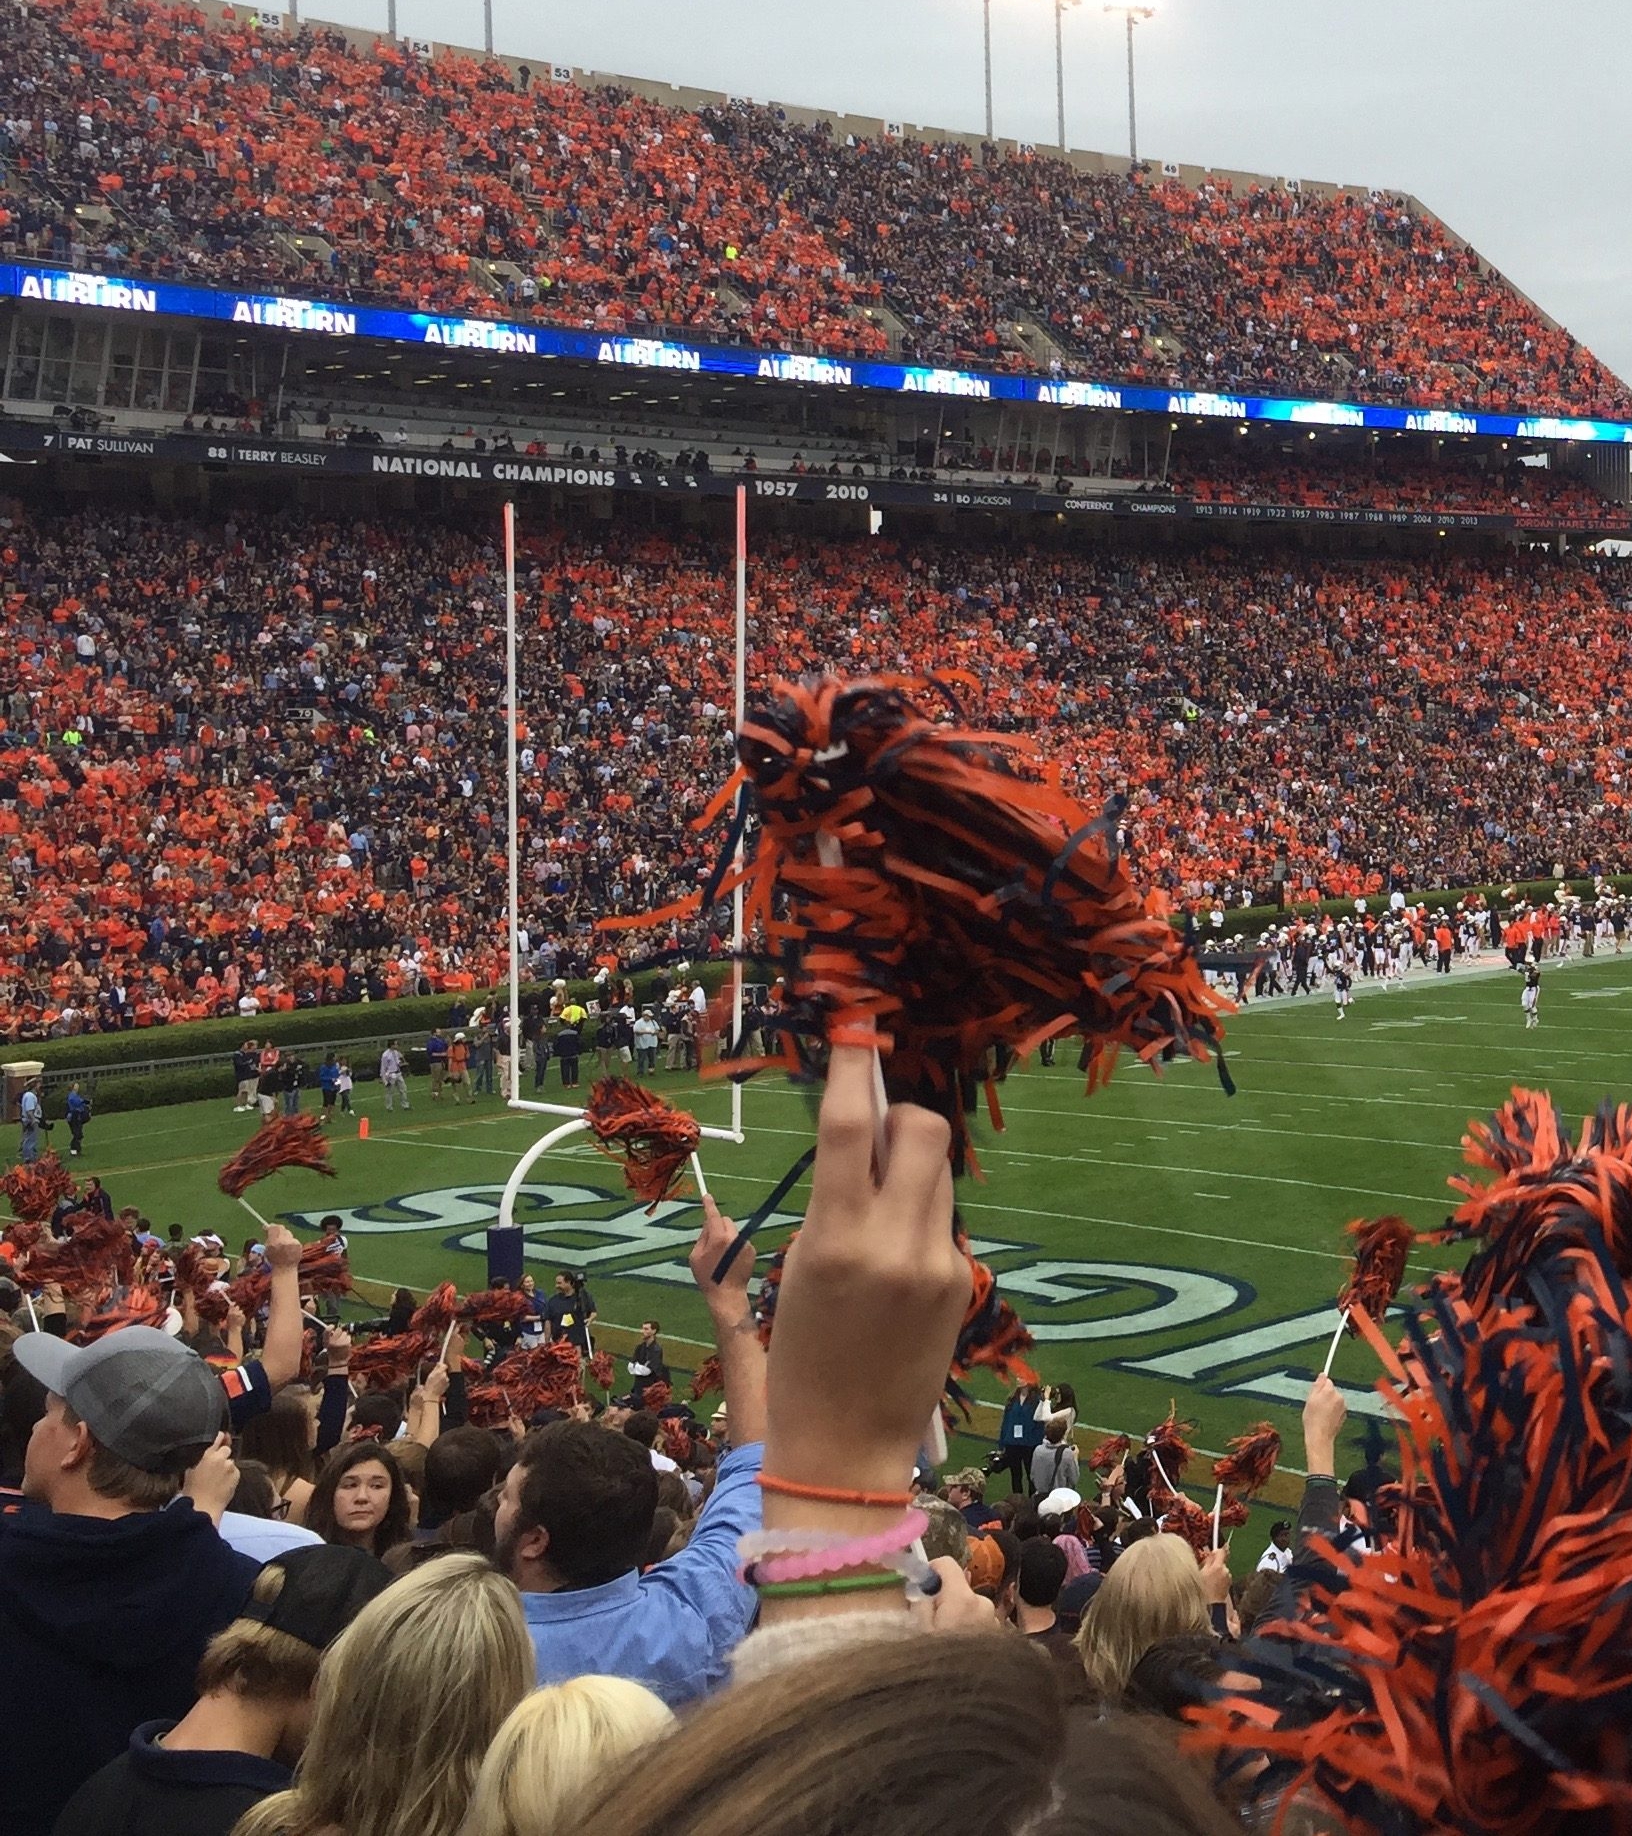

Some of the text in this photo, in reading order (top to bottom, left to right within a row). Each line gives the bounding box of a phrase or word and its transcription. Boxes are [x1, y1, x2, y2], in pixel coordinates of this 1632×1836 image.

[262, 13, 280, 25] 55
[413, 42, 429, 53] 54
[554, 67, 571, 79] 53
[888, 124, 900, 133] 51
[1164, 165, 1177, 173] 49
[20, 275, 157, 312] AUBURN
[232, 301, 356, 334] AUBURN
[424, 323, 536, 353] AUBURN
[598, 342, 700, 370] AUBURN
[758, 359, 852, 385] AUBURN
[43, 435, 154, 453] 7 PAT SULLIVAN
[207, 446, 327, 466] 88 TERRY BEASLEY
[372, 455, 616, 487] NATIONAL CHAMPIONS
[754, 480, 869, 500] 1957 2010
[933, 493, 1011, 506] 34 BO JACKSON
[1065, 499, 1177, 513] CONFERENCE CHAMPIONS
[1196, 505, 1213, 515] 1913
[1219, 506, 1237, 515] 1914
[1243, 507, 1261, 516] 1919
[1292, 509, 1310, 519] 1957
[1316, 510, 1335, 520] 1983
[1340, 511, 1359, 521] 1987
[1389, 513, 1407, 522] 1989
[1413, 515, 1432, 524] 2004
[1437, 515, 1455, 525] 2010
[1461, 517, 1478, 525] 2013
[1514, 519, 1631, 529] JORDAN HARE STADIUM
